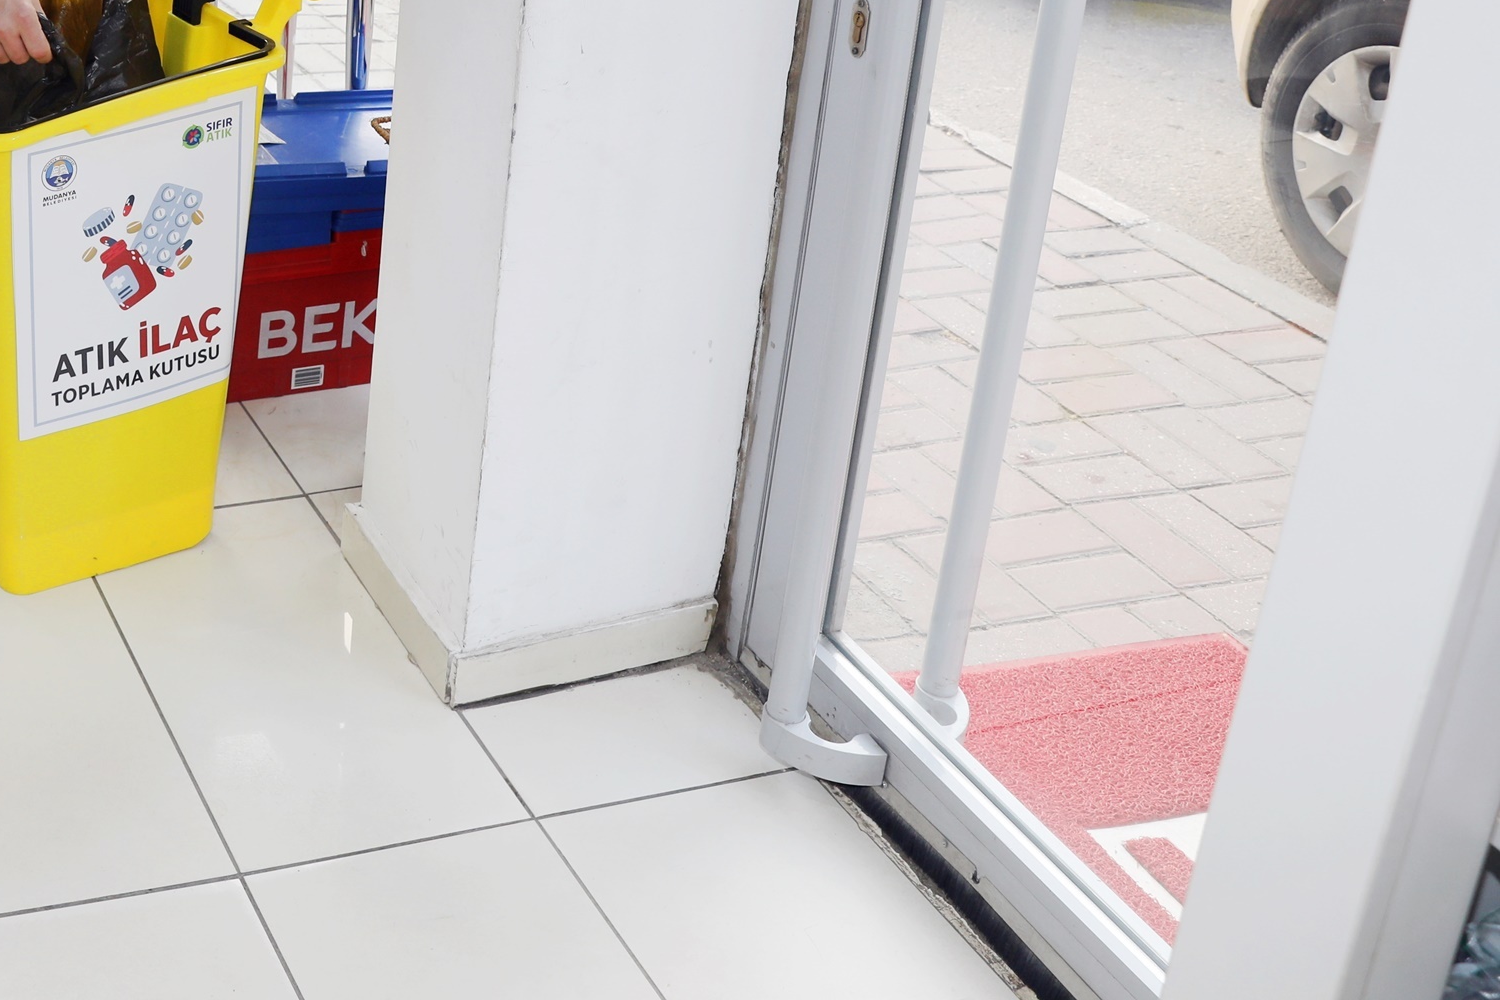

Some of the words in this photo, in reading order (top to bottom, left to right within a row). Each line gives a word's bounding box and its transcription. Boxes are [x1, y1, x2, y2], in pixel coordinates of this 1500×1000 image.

[206, 117, 233, 132] SIFIR
[206, 128, 233, 144] ATIK
[43, 190, 77, 202] MUDANYA
[52, 336, 129, 383] ATIK
[139, 306, 222, 360] İLAÇ
[257, 297, 378, 360] BEK
[51, 368, 144, 407] TOPLAMA
[149, 343, 221, 381] KUTUSU
